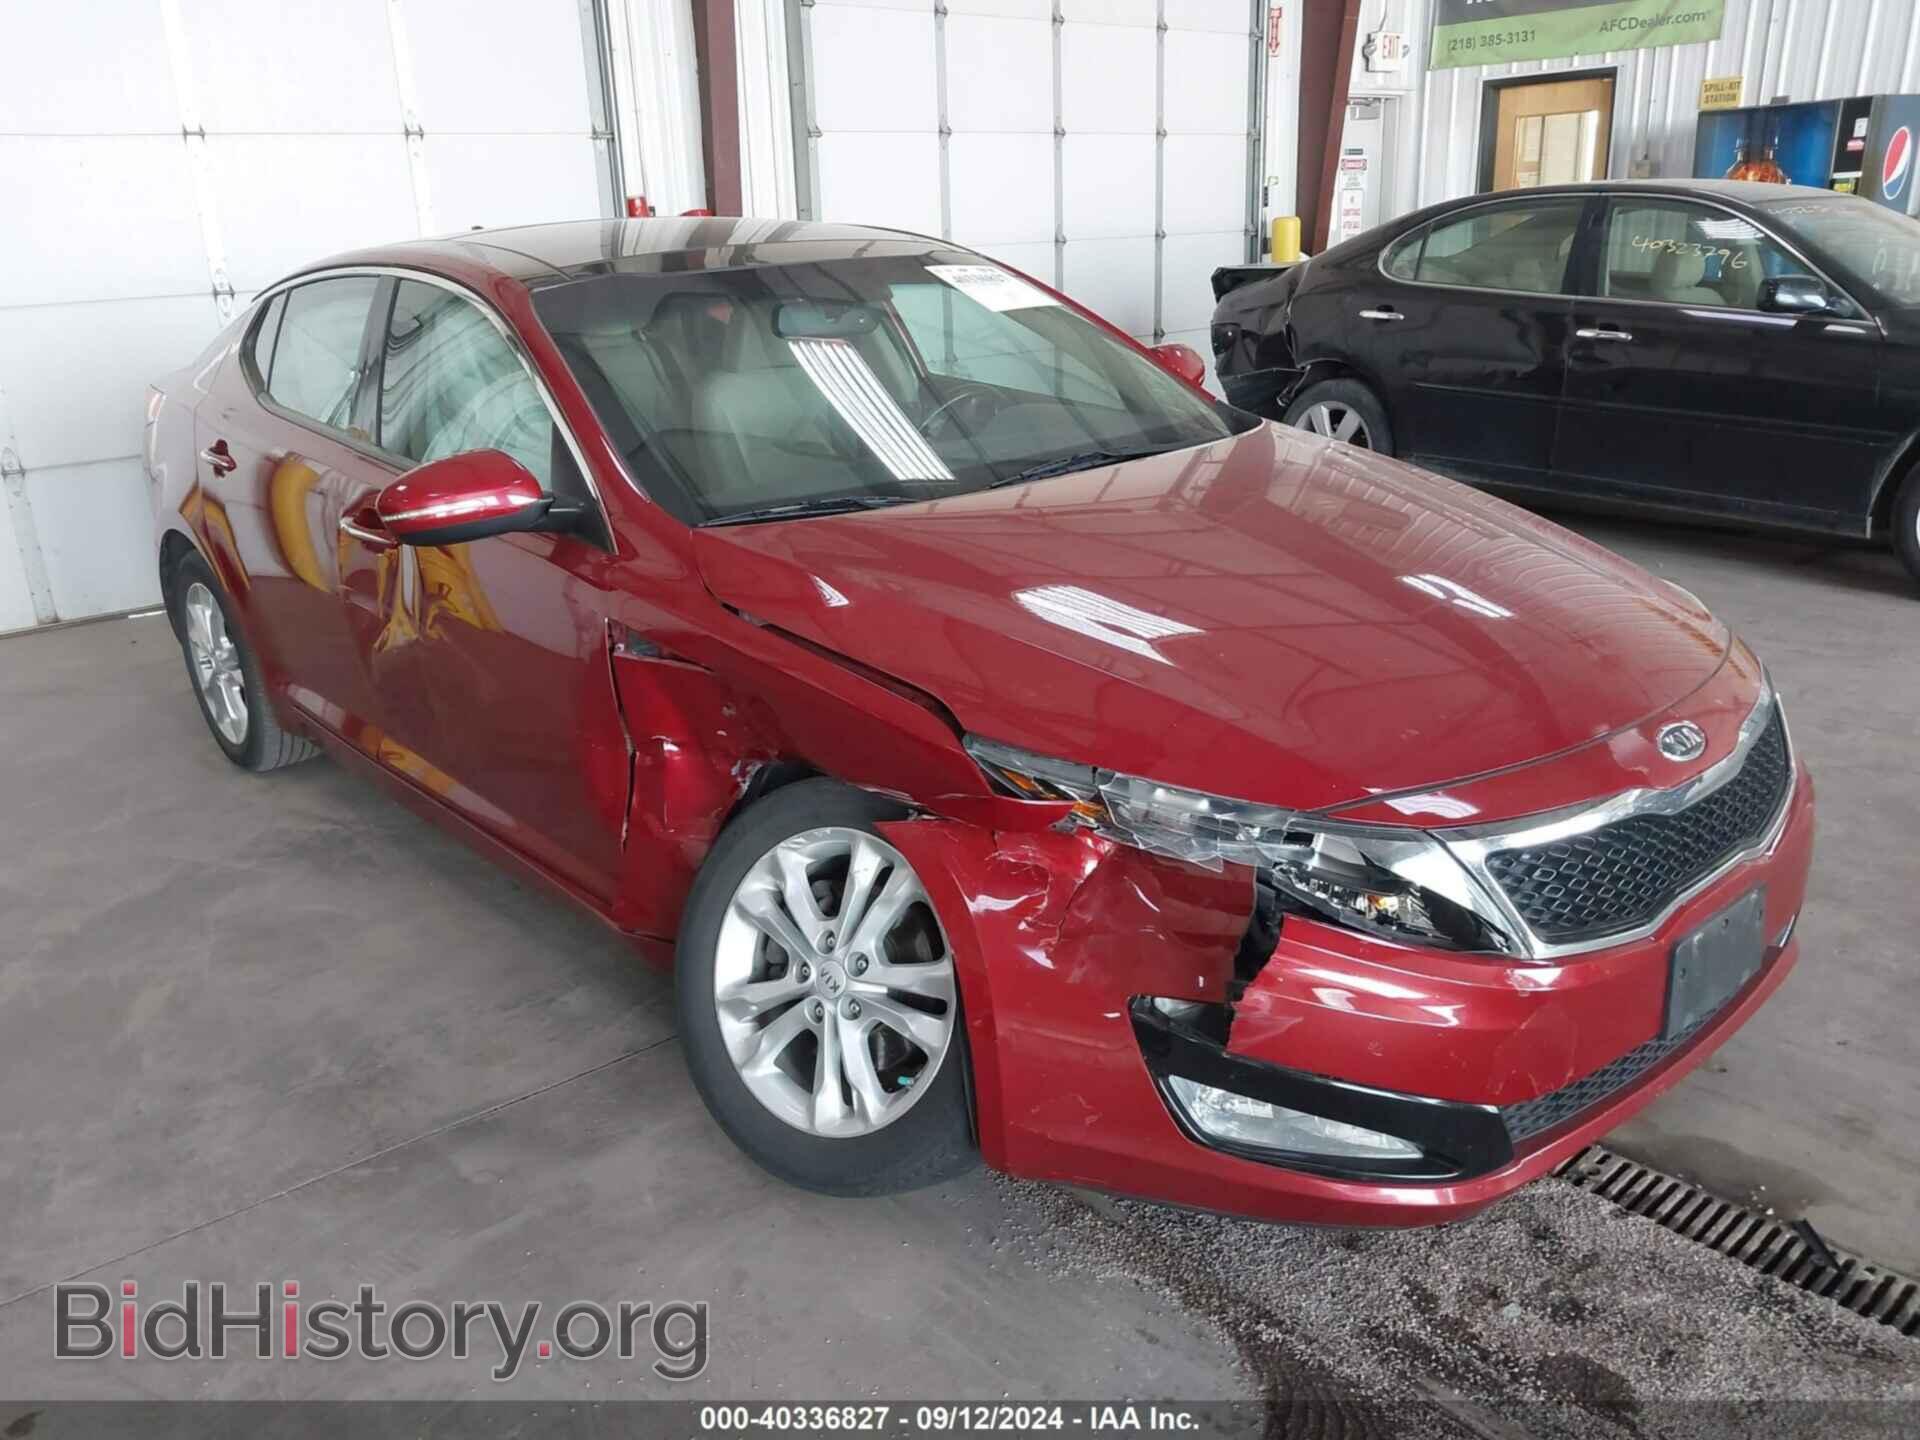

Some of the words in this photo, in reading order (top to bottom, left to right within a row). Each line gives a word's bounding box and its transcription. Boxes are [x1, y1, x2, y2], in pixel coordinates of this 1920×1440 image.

[1599, 11, 1706, 33] AFCDealer.com
[1447, 37, 1476, 53] (218)
[1479, 29, 1536, 48] 385-3131
